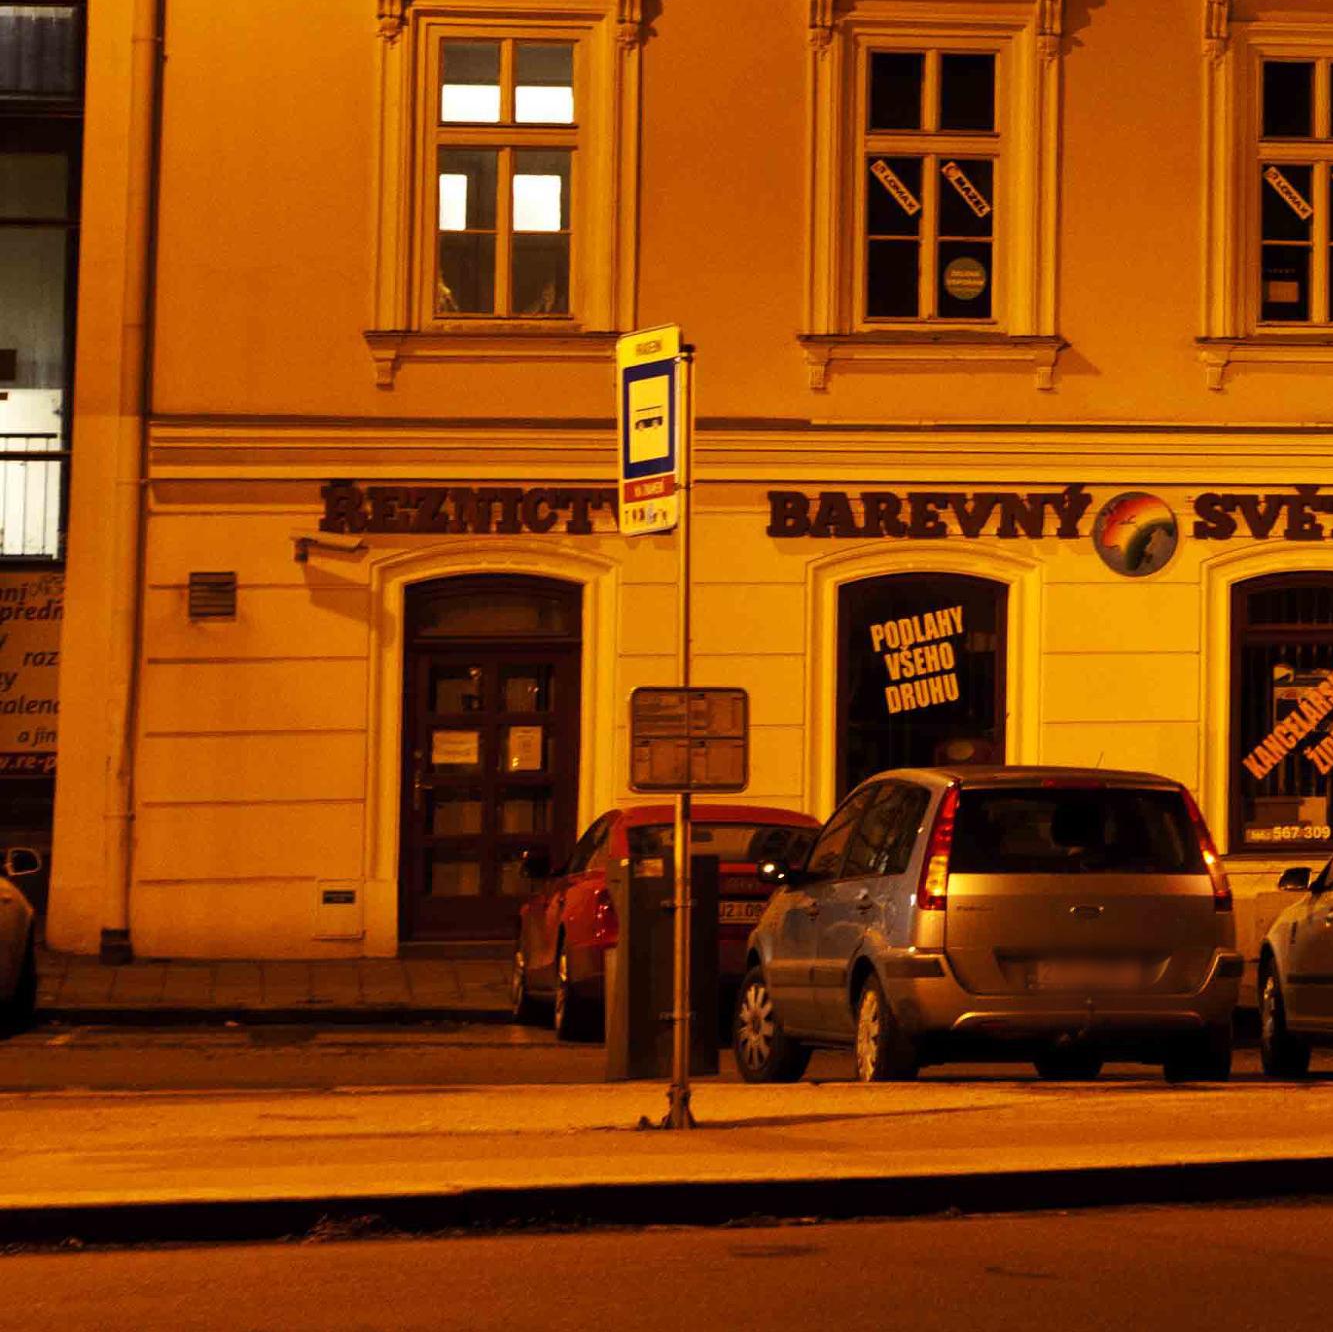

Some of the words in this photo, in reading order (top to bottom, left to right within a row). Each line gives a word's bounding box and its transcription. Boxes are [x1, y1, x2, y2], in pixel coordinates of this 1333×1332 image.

[767, 483, 1093, 539] BAREVNÝ
[870, 606, 964, 653] PODLAHY
[884, 642, 955, 681] VŠEHO
[885, 672, 960, 714] DRUHU
[1273, 825, 1299, 840] 567
[1303, 825, 1331, 839] 309
